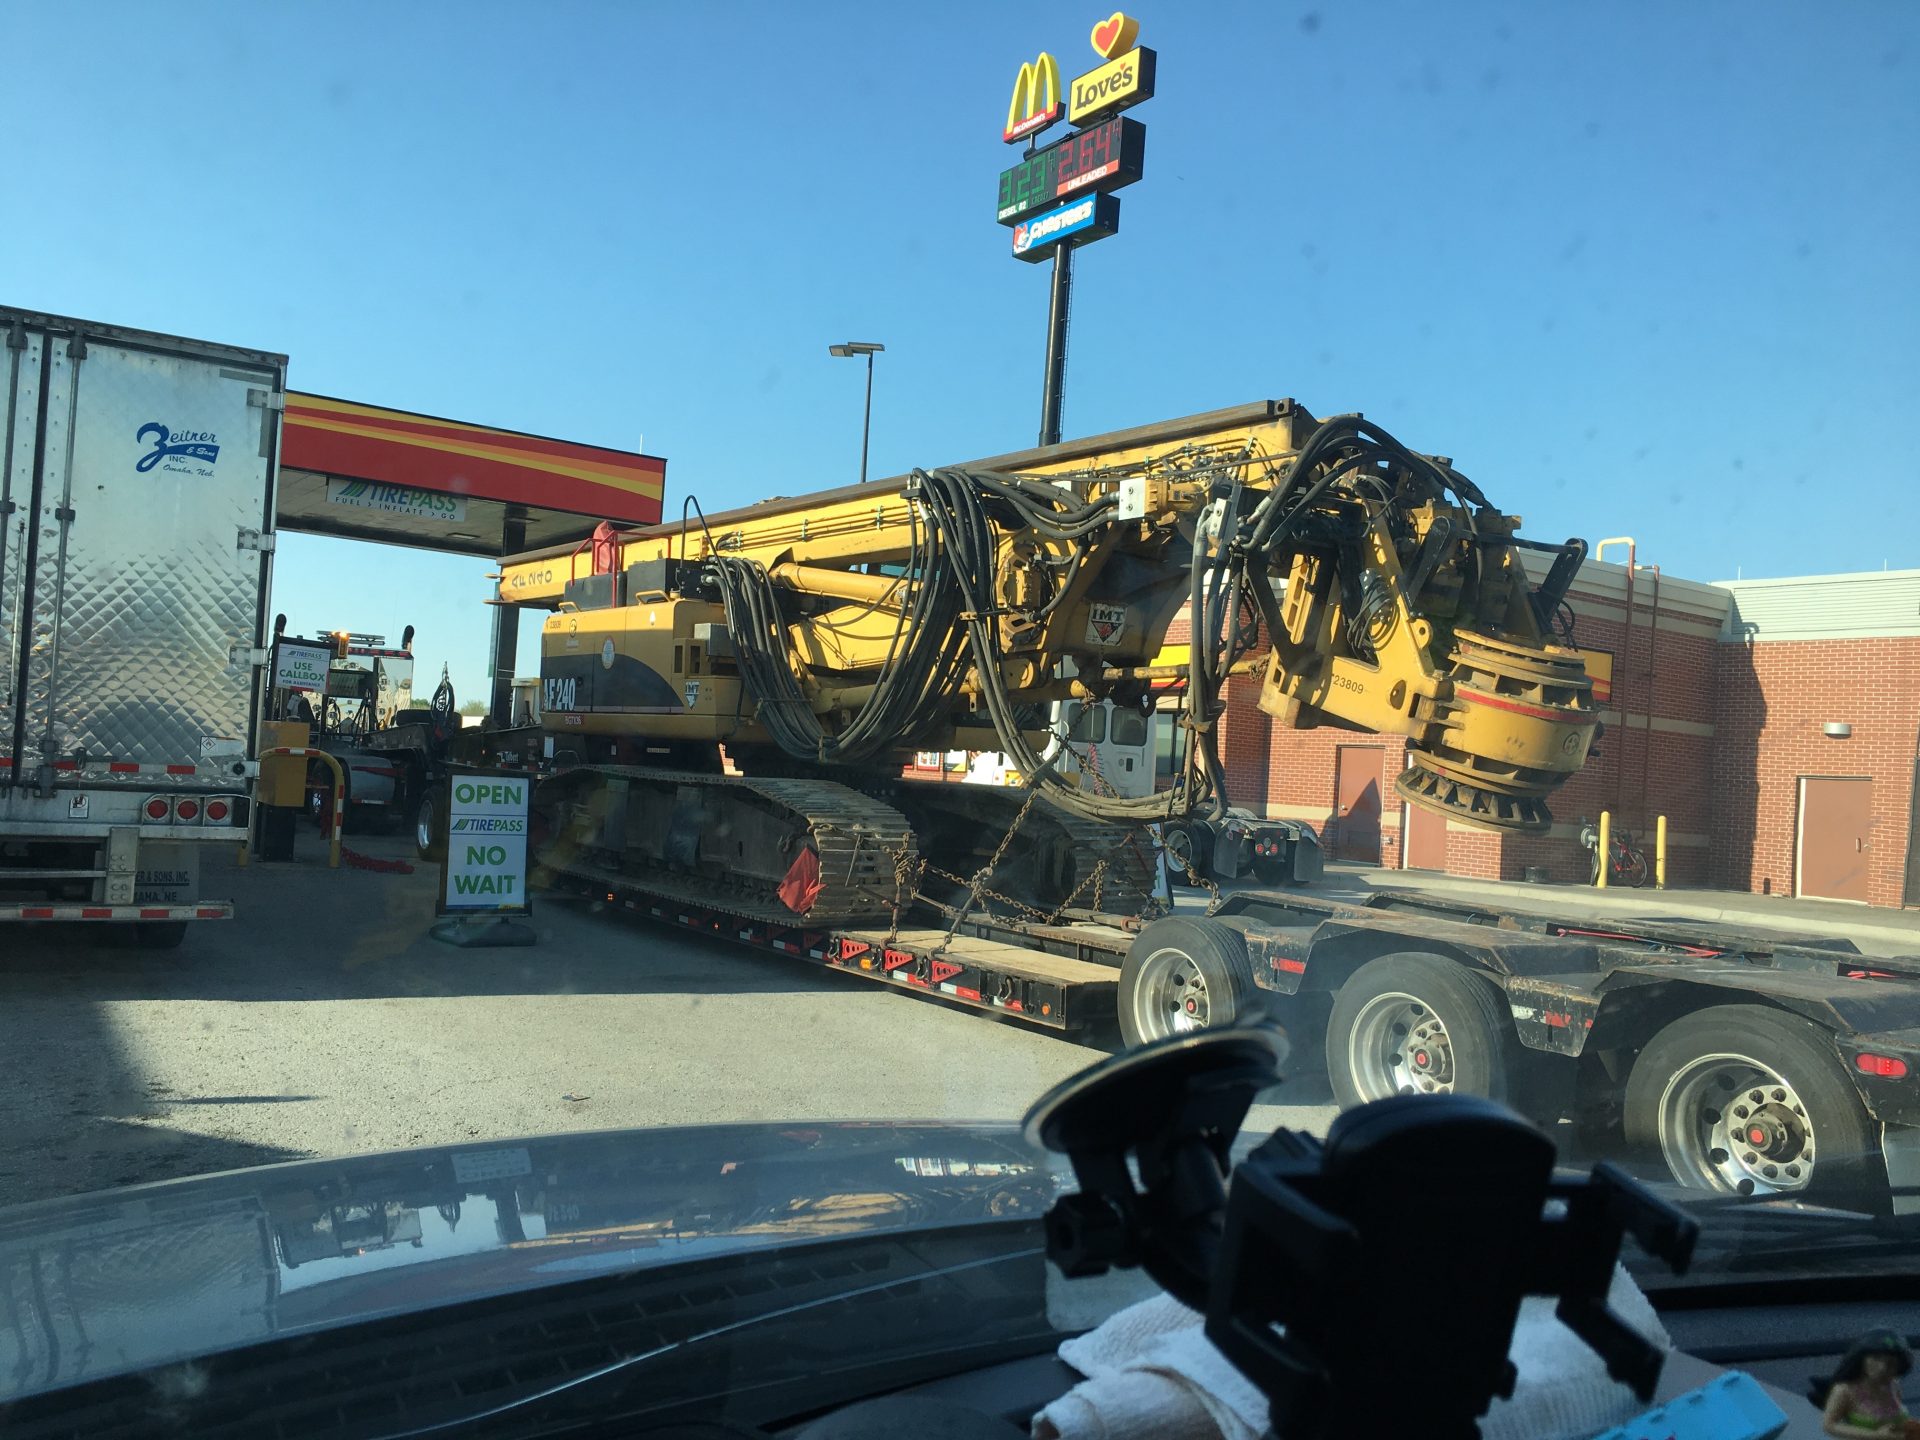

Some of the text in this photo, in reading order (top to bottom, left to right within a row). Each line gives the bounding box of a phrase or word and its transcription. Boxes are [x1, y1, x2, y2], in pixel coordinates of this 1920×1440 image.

[1075, 63, 1132, 110] Love's
[999, 155, 1046, 208] 3.23
[1067, 165, 1108, 190] UNLEADED
[998, 205, 1017, 219] DIESEL
[335, 496, 360, 506] FUEL
[380, 503, 423, 516] INFLATE
[369, 480, 456, 512] TIREPASS
[1093, 609, 1124, 621] IMT
[279, 669, 325, 681] CALLBOX
[294, 661, 313, 671] USE
[1332, 673, 1364, 694] 23809
[556, 678, 575, 711] 240
[455, 783, 522, 805] OPEN
[469, 819, 523, 831] TIREPASS
[466, 845, 507, 865] NO
[454, 875, 516, 894] WAIT
